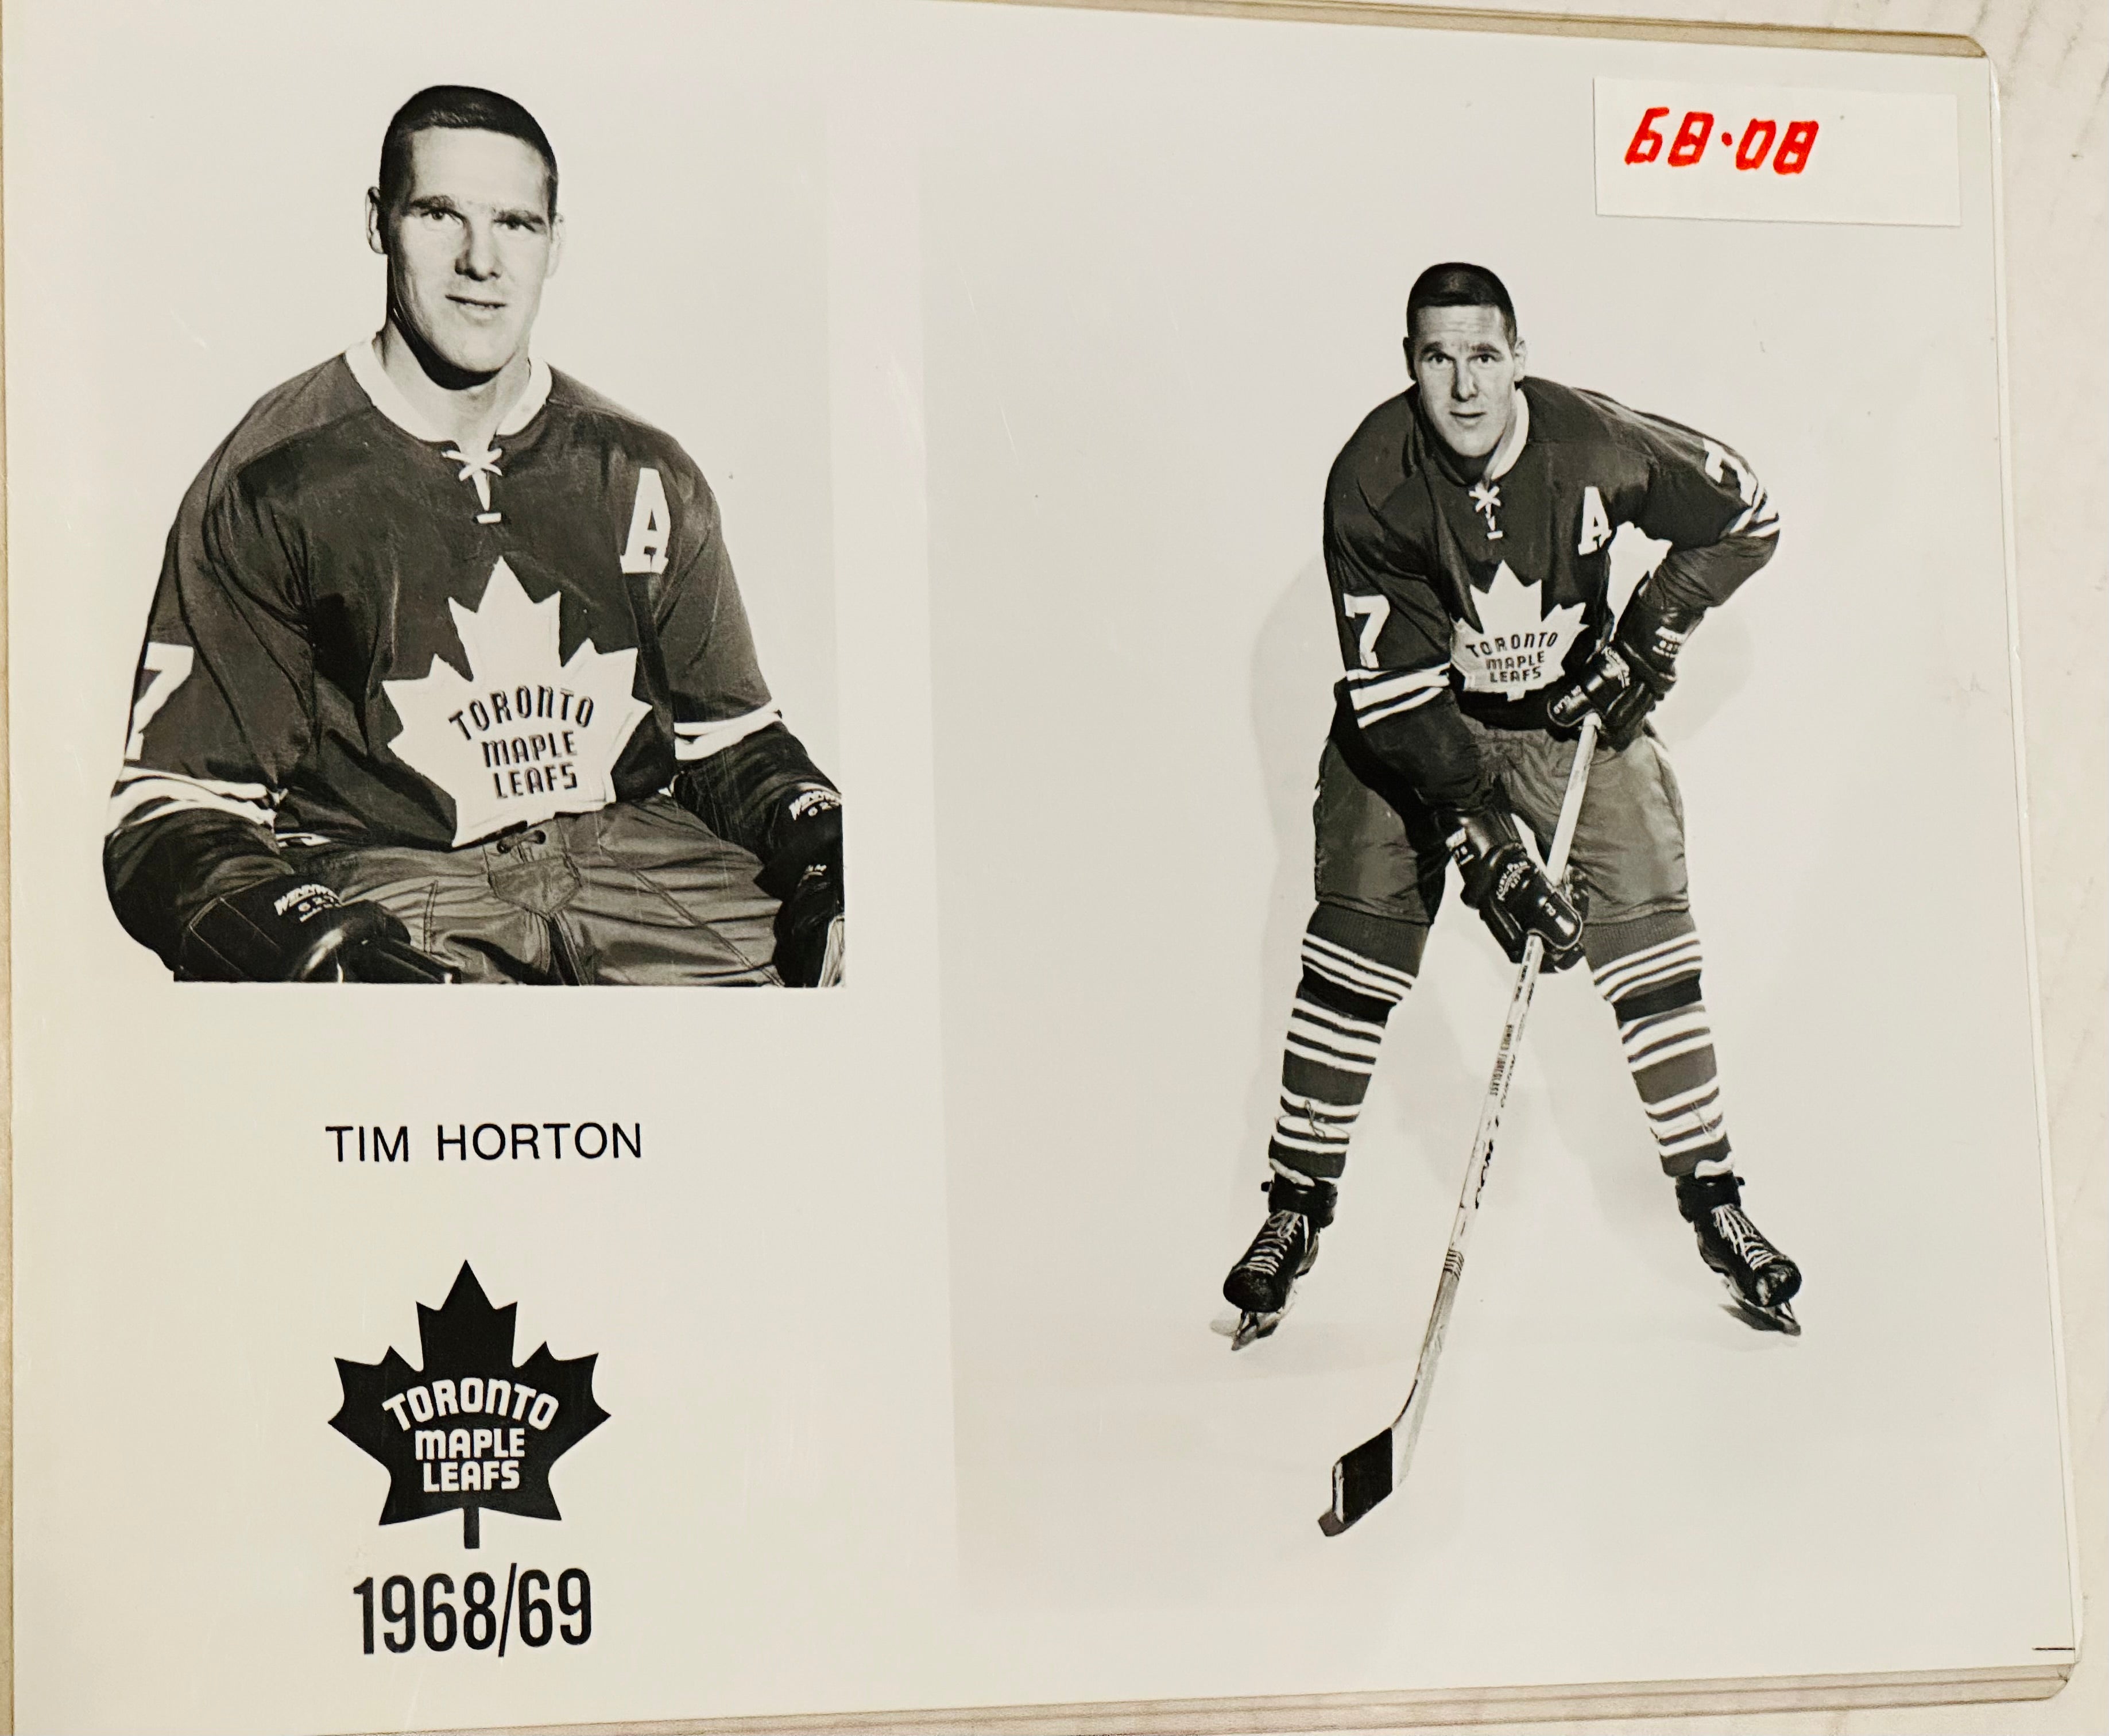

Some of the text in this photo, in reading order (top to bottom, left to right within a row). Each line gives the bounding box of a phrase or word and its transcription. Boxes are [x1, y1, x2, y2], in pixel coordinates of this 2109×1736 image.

[620, 467, 671, 574] A
[1578, 486, 1612, 555] A
[1343, 592, 1391, 668] 7
[1465, 632, 1558, 658] TORONTO
[1485, 650, 1545, 670] MAPLE
[1489, 666, 1542, 683] LEAFS
[125, 641, 194, 760] 7
[448, 684, 594, 741] TORONTO
[481, 730, 577, 768] MAPLE
[492, 761, 578, 799] LEAFS
[325, 1122, 641, 1162] TIM HORTON
[382, 1377, 559, 1431] TORONTO
[415, 1427, 525, 1460] MAPLE
[423, 1459, 520, 1493] LEAFS
[353, 1562, 593, 1658] 1968/69
